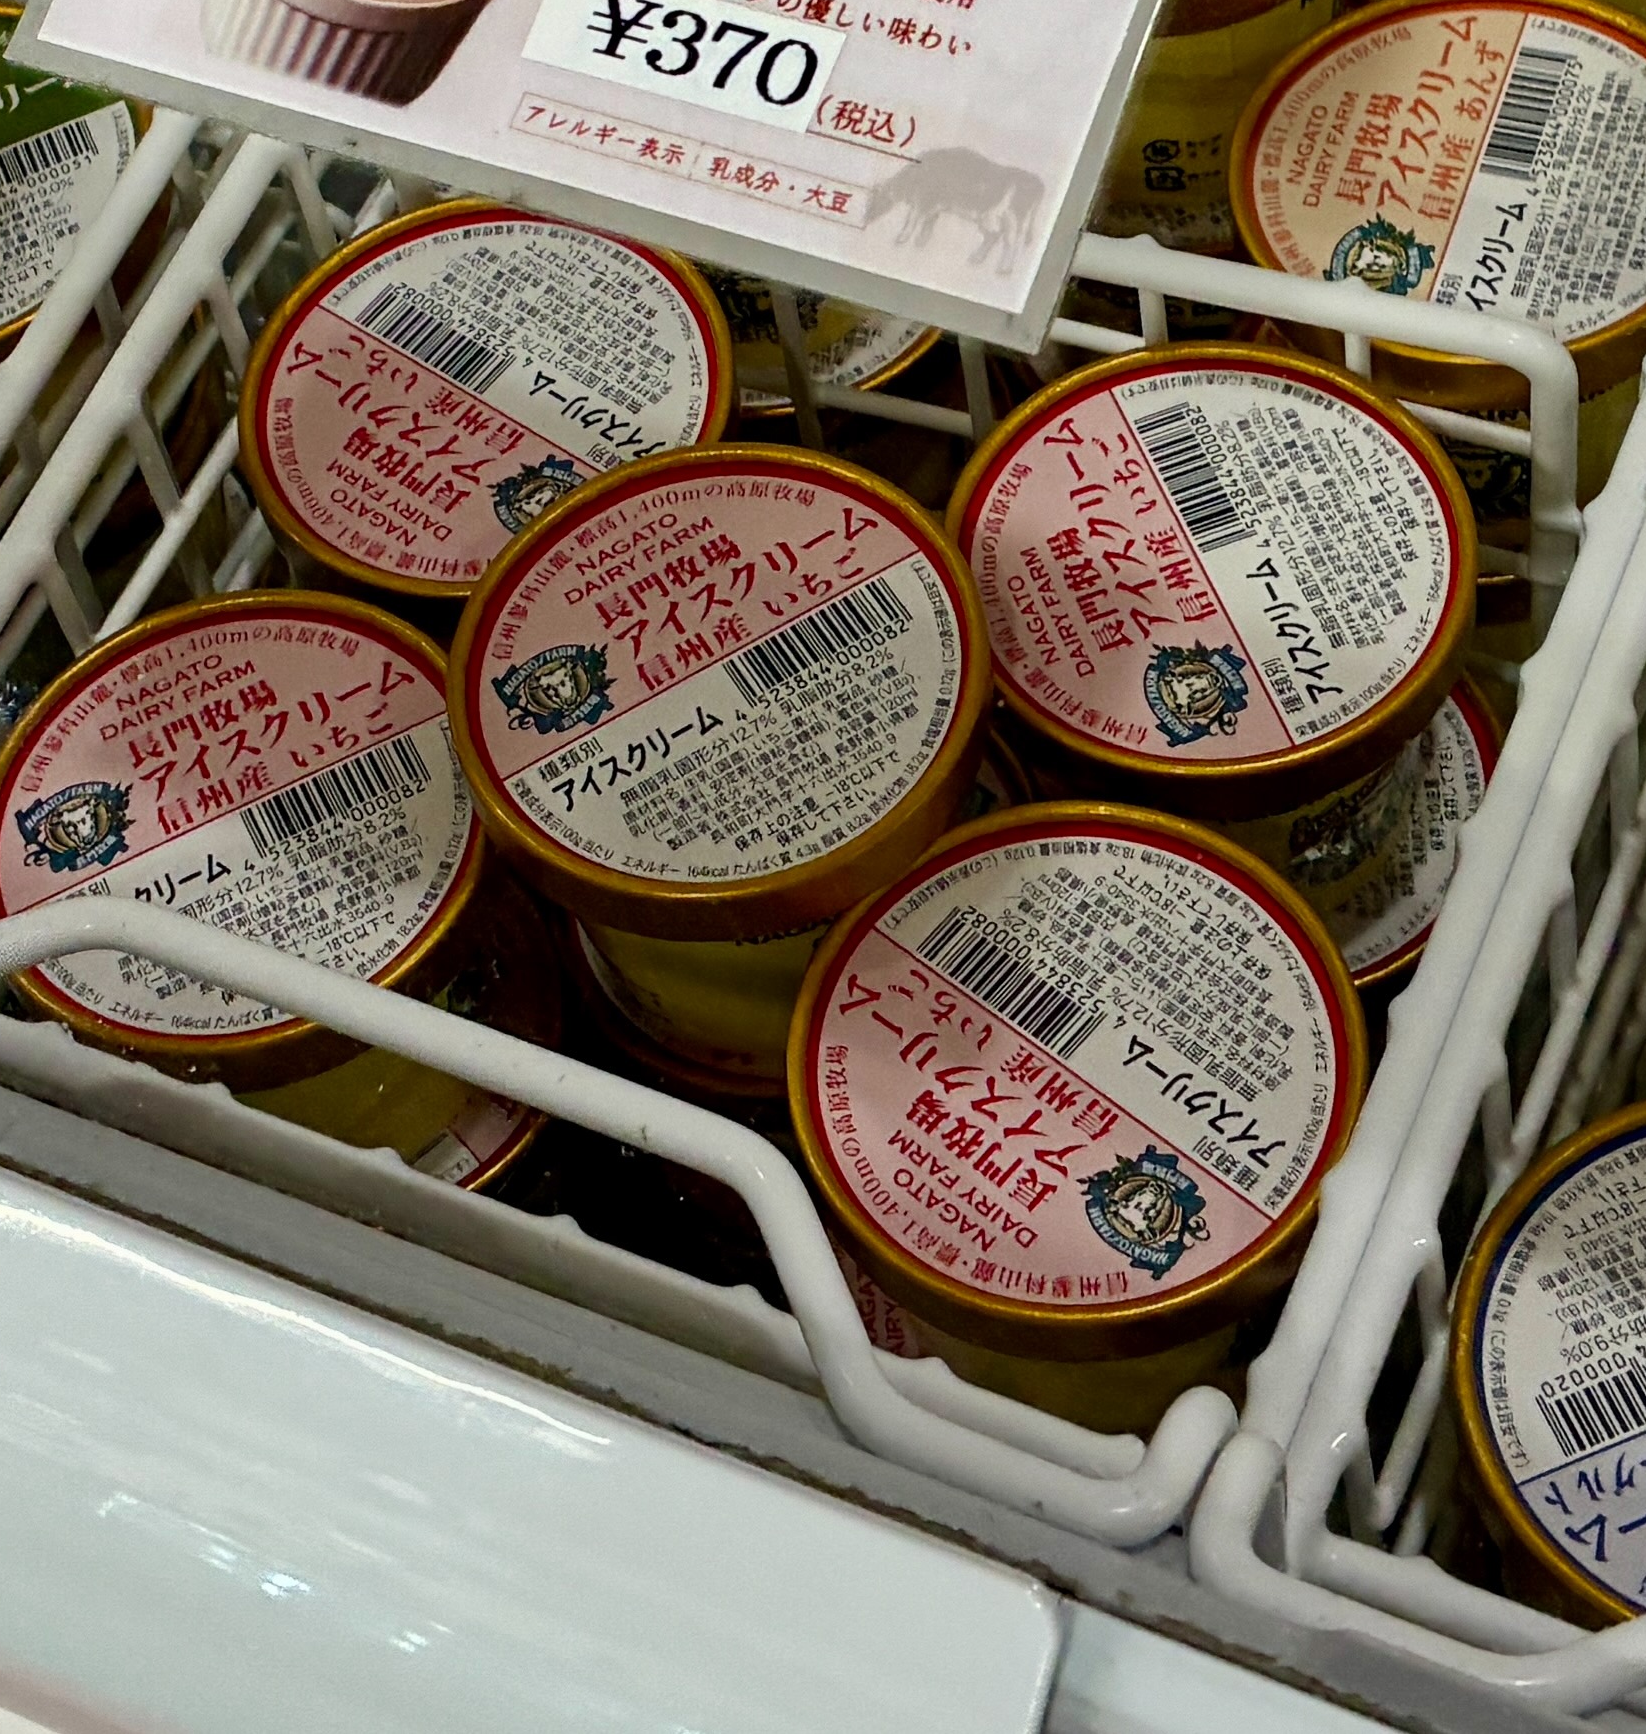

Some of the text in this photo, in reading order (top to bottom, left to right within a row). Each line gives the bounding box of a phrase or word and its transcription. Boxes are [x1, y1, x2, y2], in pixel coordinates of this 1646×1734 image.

[815, 94, 919, 146] （税込）
[1375, 9, 1481, 213] アイスクリーム
[1455, 41, 1504, 121] あんず
[524, 104, 853, 214] アレルギー表示 乳成分・大豆
[1285, 103, 1328, 185] NAGATO
[1303, 149, 1338, 209] DAIRY
[1336, 90, 1402, 205] 長門牧場
[282, 343, 496, 483] アイスクリーム
[329, 329, 523, 454] 信州産 いちご
[326, 458, 452, 541] DAIRY FARM
[327, 487, 418, 547] NAGATO
[342, 426, 469, 514] 長門牧場
[564, 516, 714, 604] DAIRY FARM
[574, 511, 680, 576] NAGATO
[1038, 419, 1178, 638] アイスクリーム
[1093, 427, 1216, 624] 信州産 いちご
[594, 535, 742, 627] 長門牧場
[612, 502, 878, 659] アイスクリーム
[636, 550, 864, 688] 信州産 いちご
[1004, 573, 1063, 665] NAGATO
[1019, 546, 1098, 677] DAIRY FARM
[1046, 527, 1133, 654] 長門牧場
[1245, 557, 1341, 703] アイスクリーム
[98, 660, 256, 741] DAIRY FARM
[115, 653, 223, 711] NAGATO
[126, 680, 279, 767] 長門牧場
[139, 657, 414, 801] アイスクリーム
[757, 660, 832, 708] 523844
[155, 706, 396, 833] 信州産 いちご
[552, 703, 724, 811] アイスクリーム
[268, 778, 425, 860] 523844 000082
[1156, 871, 1253, 947] 保存して下さい。
[1190, 916, 1272, 981] 保存上の注意
[958, 905, 1103, 1015] 523844 000082
[830, 976, 1087, 1177] アイスクリーム
[892, 964, 1118, 1140] 信州産 いちご
[1118, 1034, 1284, 1167] アイスクリーム
[887, 1129, 1039, 1246] DAIRY FARM
[906, 1090, 1056, 1211] 長門牧場
[1193, 1136, 1259, 1191] 種類別
[891, 1166, 997, 1250] NAGATO
[1541, 1352, 1625, 1396] 000020
